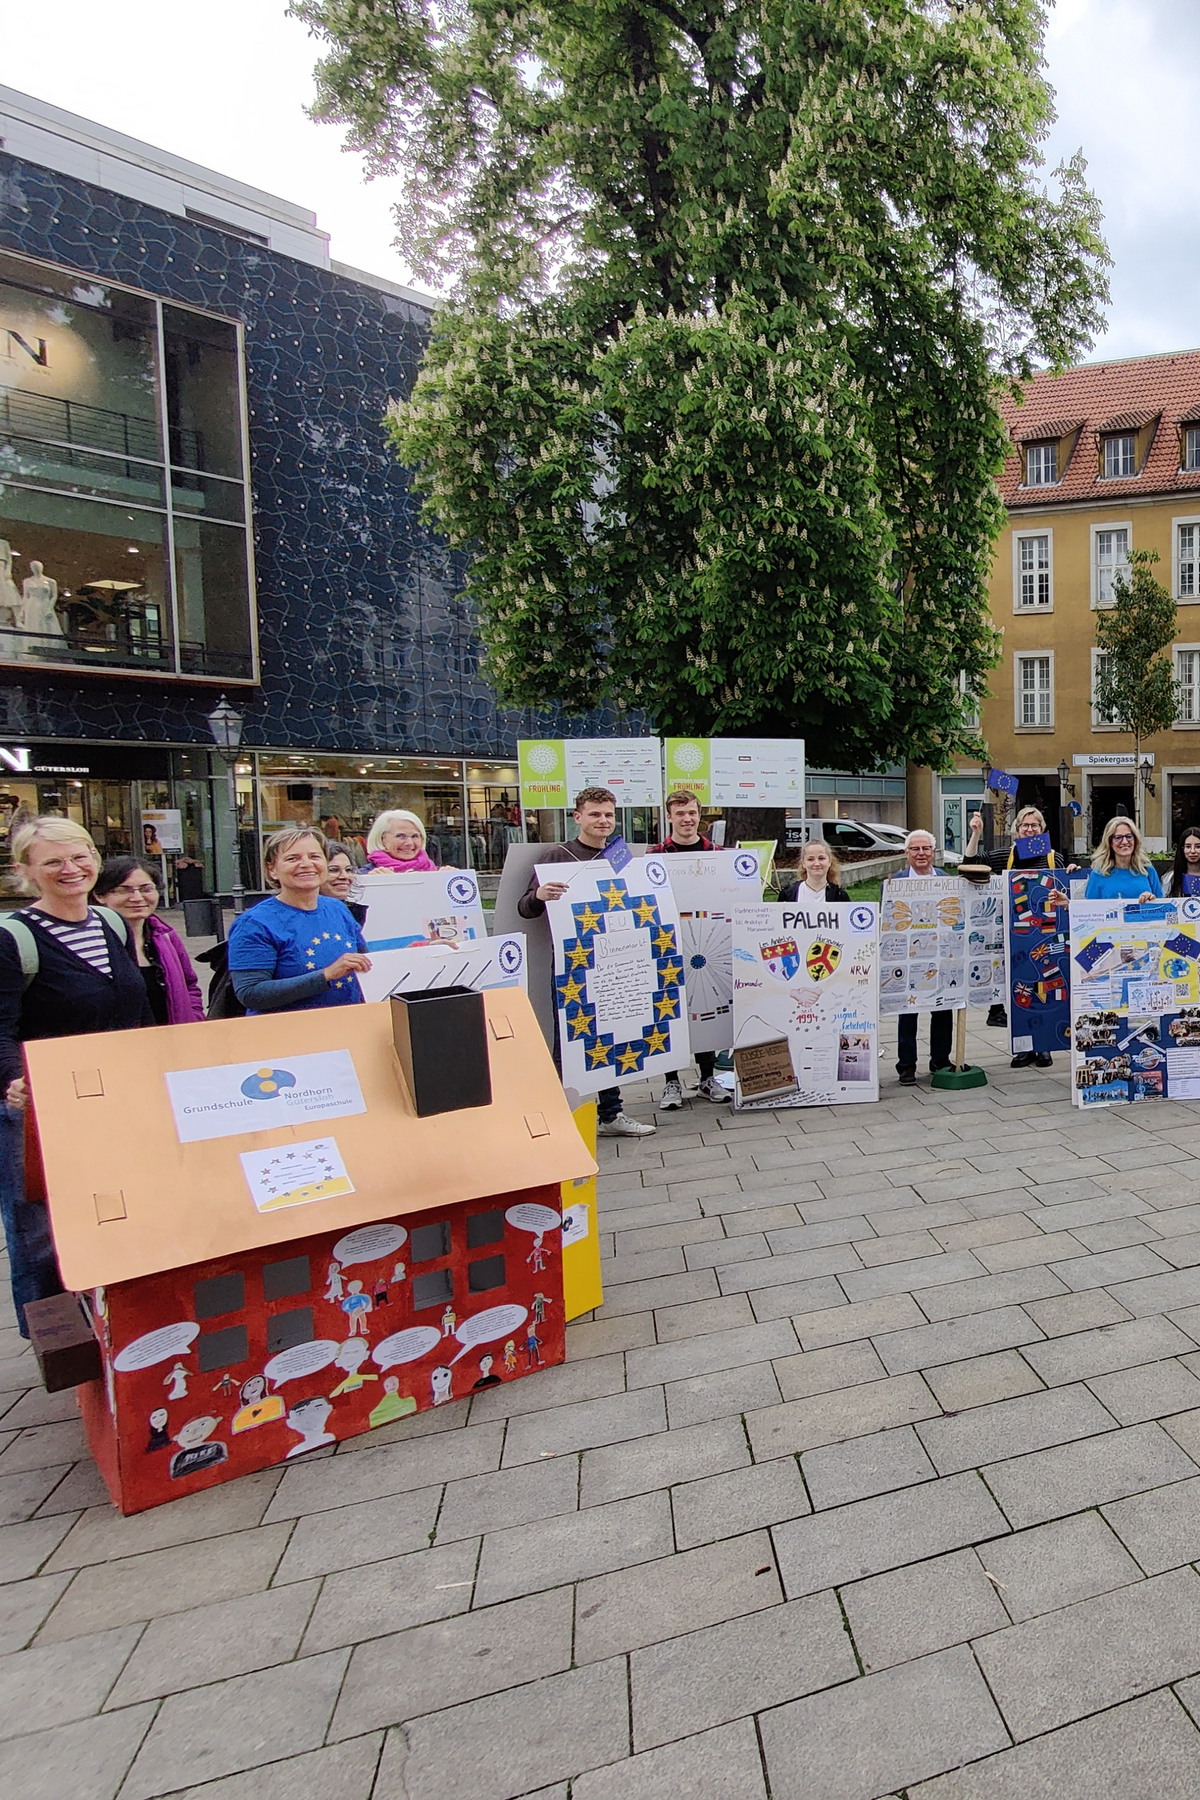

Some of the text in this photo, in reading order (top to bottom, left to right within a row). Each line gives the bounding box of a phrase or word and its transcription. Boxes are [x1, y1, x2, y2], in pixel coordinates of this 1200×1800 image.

[608, 915, 627, 928] EU
[782, 911, 840, 930] PALAH
[598, 937, 647, 958] Binnenmarkt
[850, 964, 872, 976] NRW
[796, 1013, 819, 1024] 1994
[284, 1087, 333, 1100] Nordhorn
[286, 1093, 335, 1107] Gütersloh
[183, 1098, 254, 1115] Grundschule
[304, 1098, 353, 1111] Europaschule
